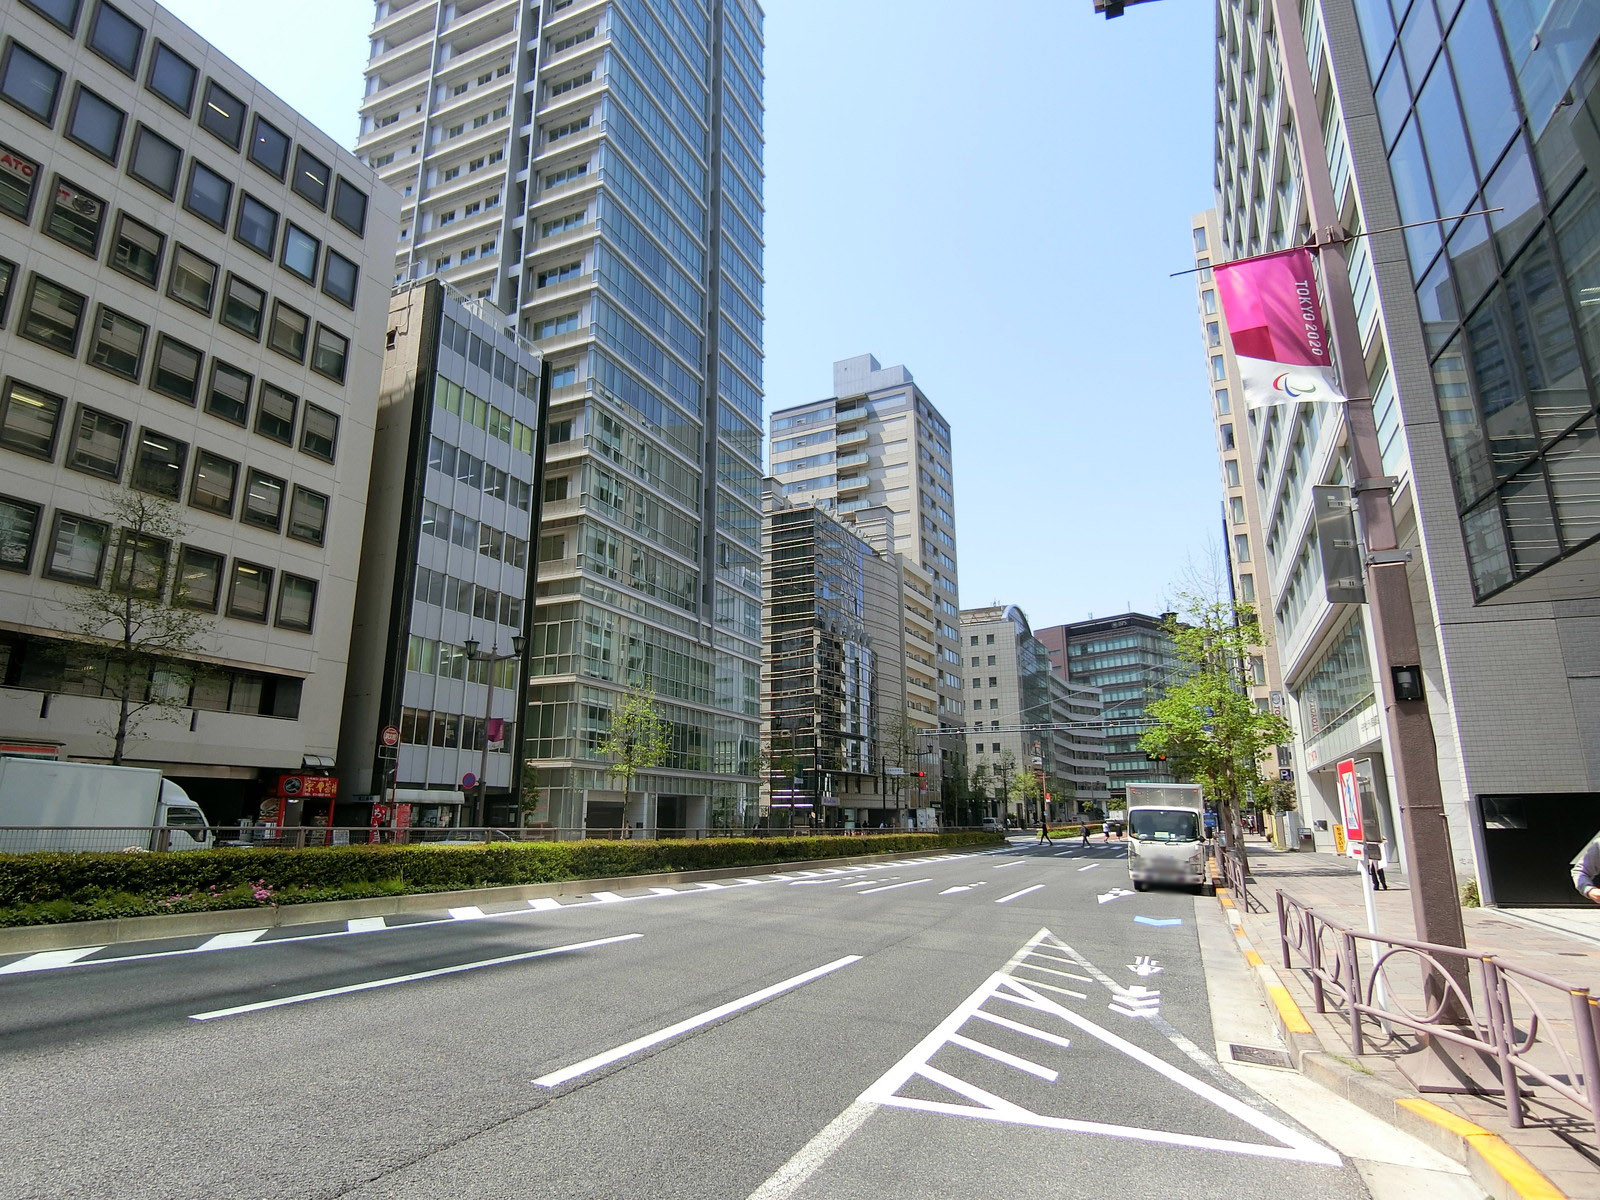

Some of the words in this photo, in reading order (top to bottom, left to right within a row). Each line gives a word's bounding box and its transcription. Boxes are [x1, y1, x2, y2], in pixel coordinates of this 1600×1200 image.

[1294, 280, 1315, 321] TOKYO
[1304, 323, 1323, 356] 2020
[1280, 770, 1289, 780] P
